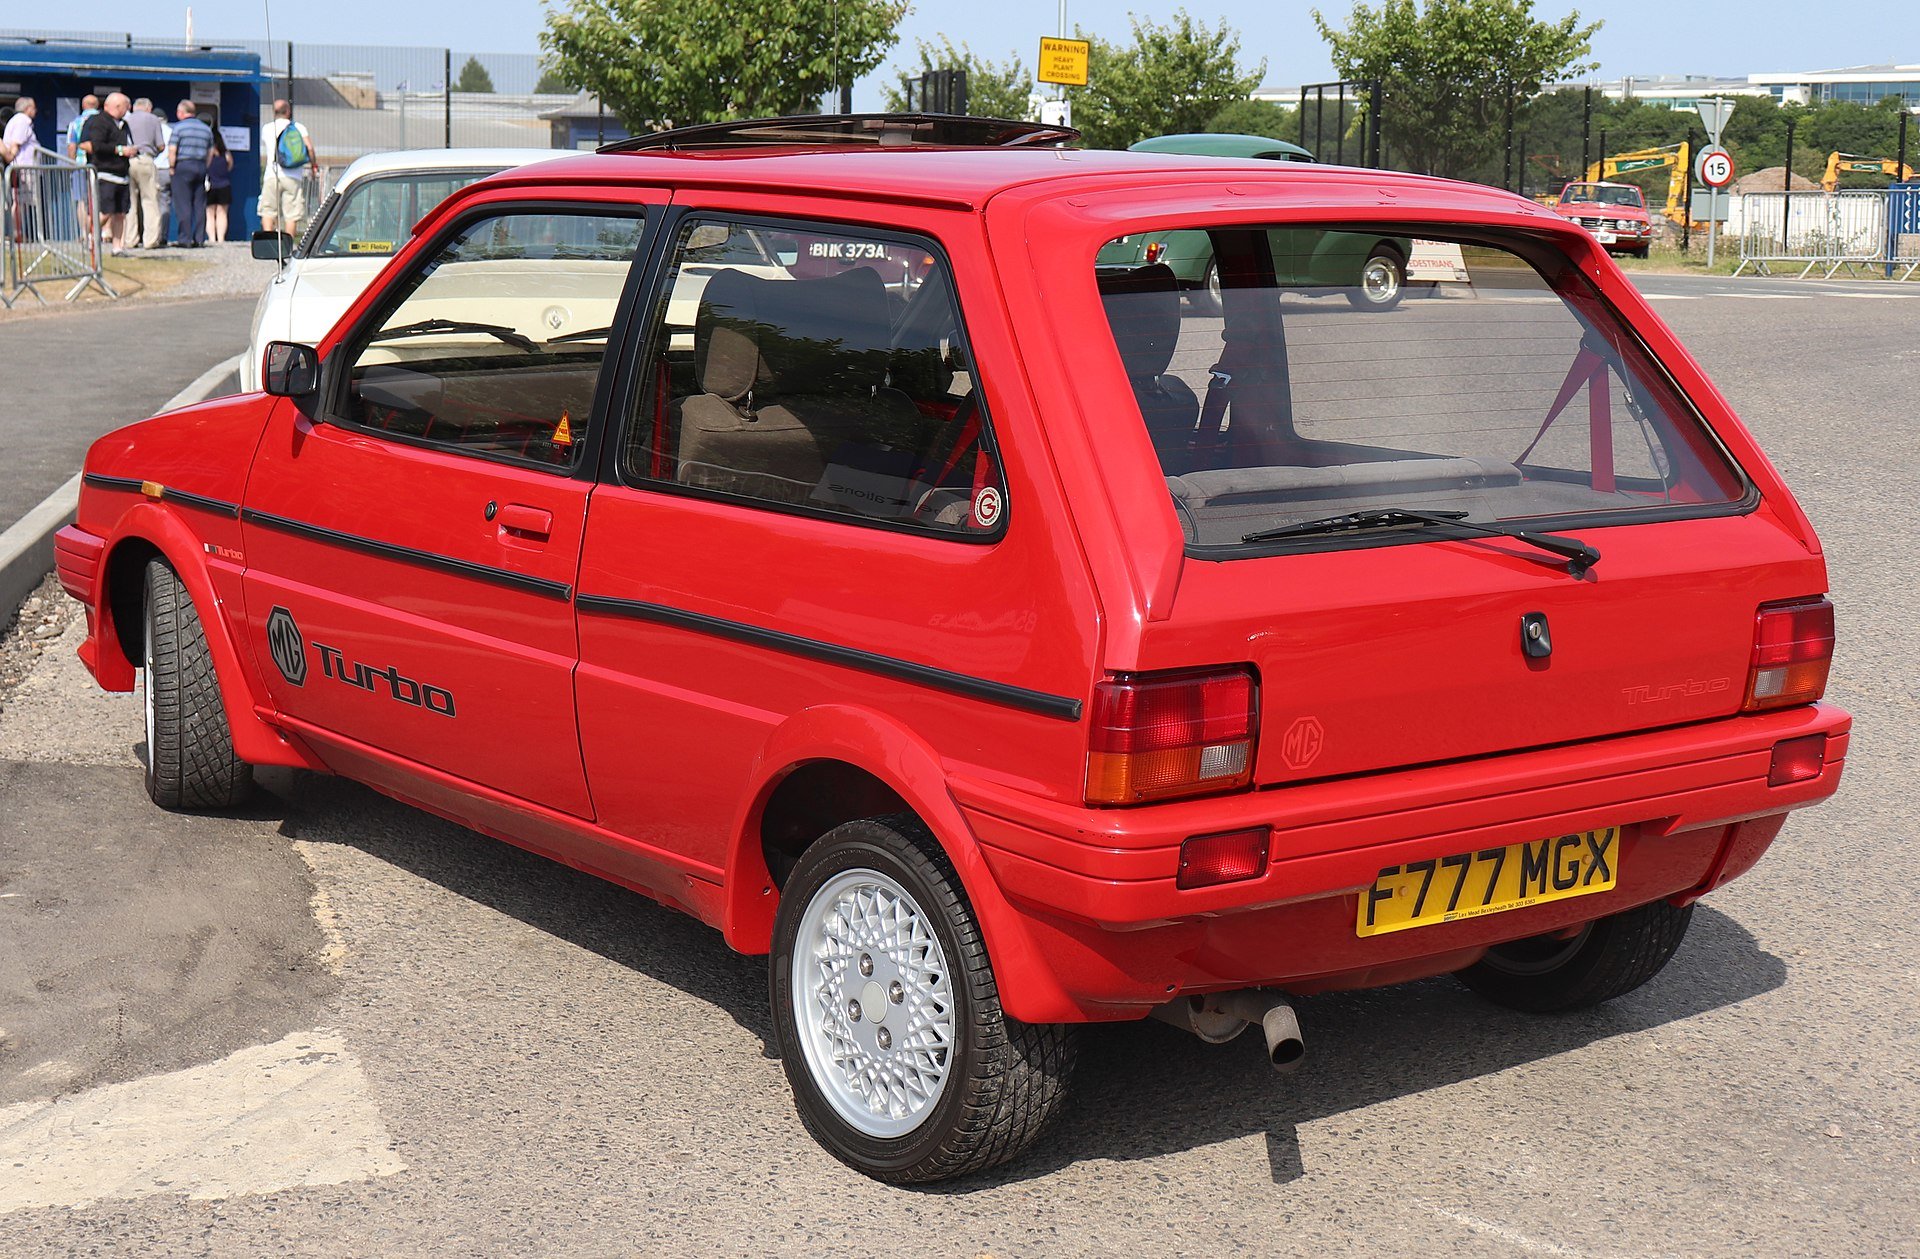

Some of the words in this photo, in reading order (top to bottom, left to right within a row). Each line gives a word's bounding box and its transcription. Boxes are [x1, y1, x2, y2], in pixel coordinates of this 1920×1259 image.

[1044, 43, 1086, 54] WARNING
[1046, 71, 1080, 80] CROSSING
[1709, 163, 1726, 176] 15
[845, 243, 885, 258] 373A
[1408, 259, 1455, 268] EDESTRIANS
[215, 545, 244, 561] Turbo
[271, 617, 301, 675] MG
[311, 640, 456, 718] Turbo
[1621, 677, 1730, 704] Turbo
[1286, 723, 1319, 763] MG
[1366, 846, 1507, 926] F777
[1519, 828, 1614, 899] MGX
